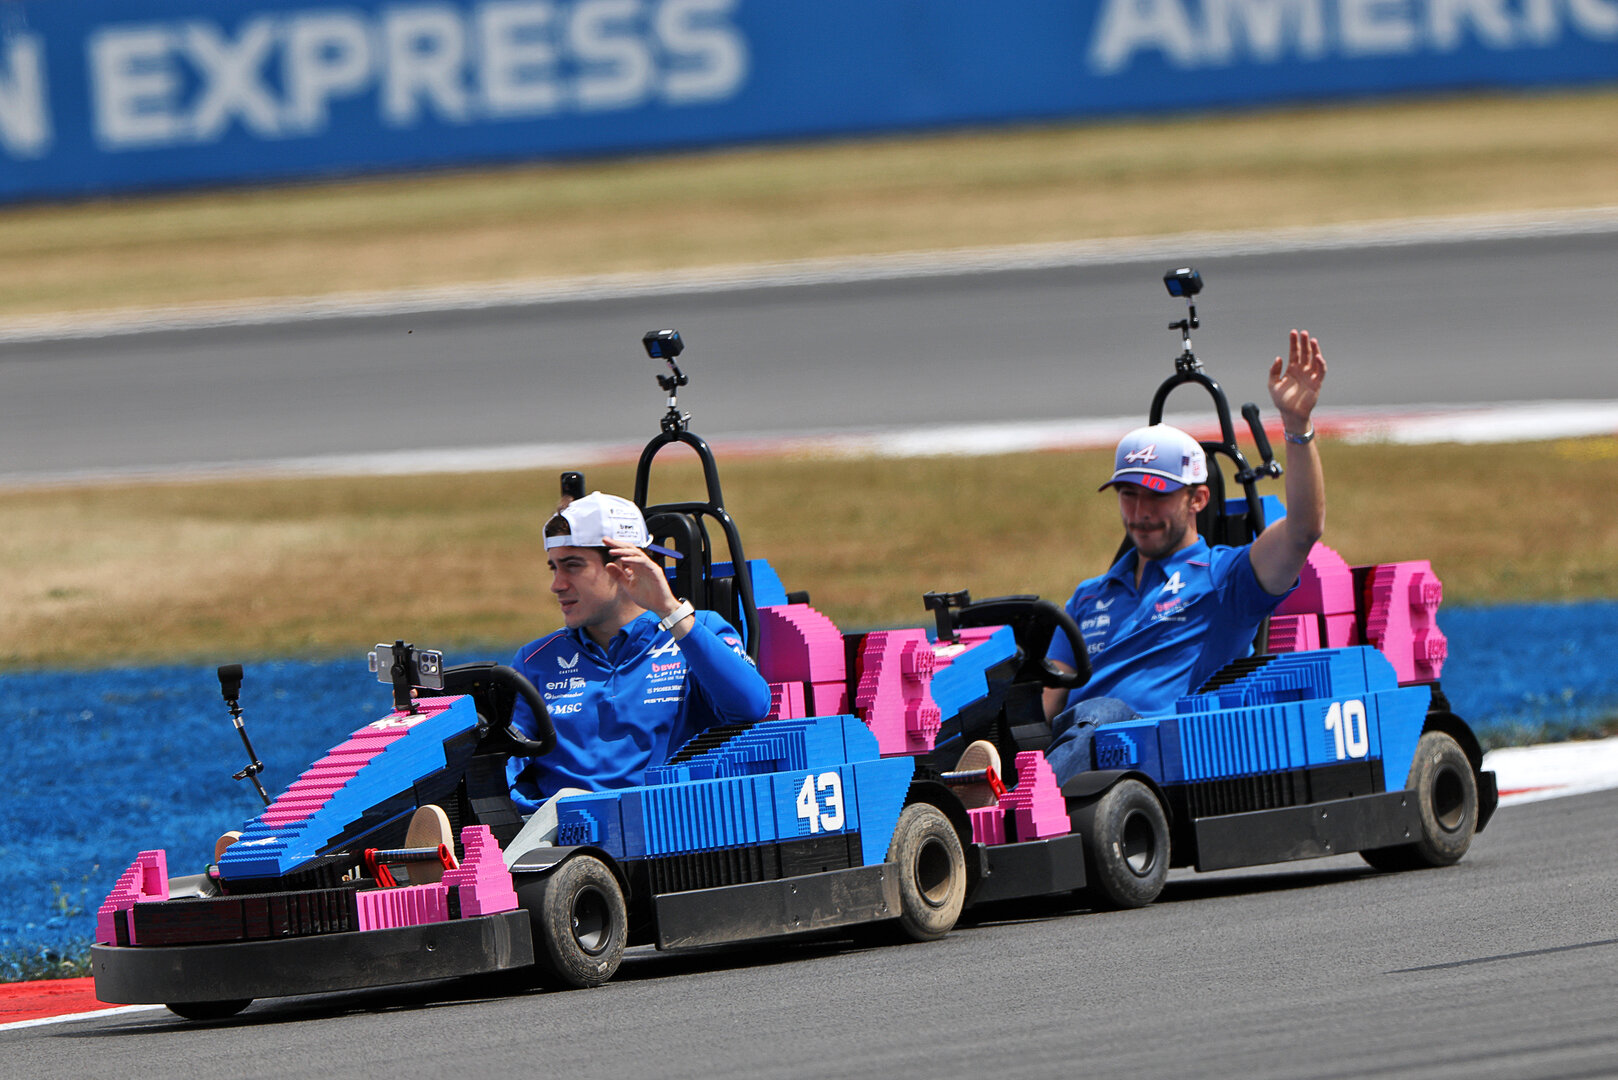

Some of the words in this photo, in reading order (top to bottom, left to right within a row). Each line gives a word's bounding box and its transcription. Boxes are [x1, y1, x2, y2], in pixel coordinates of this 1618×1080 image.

[88, 0, 748, 150] EXPRESS
[546, 678, 568, 690] eni
[660, 662, 681, 671] BWT
[554, 702, 583, 715] MSC
[1325, 699, 1369, 760] 10
[796, 771, 845, 834] 43
